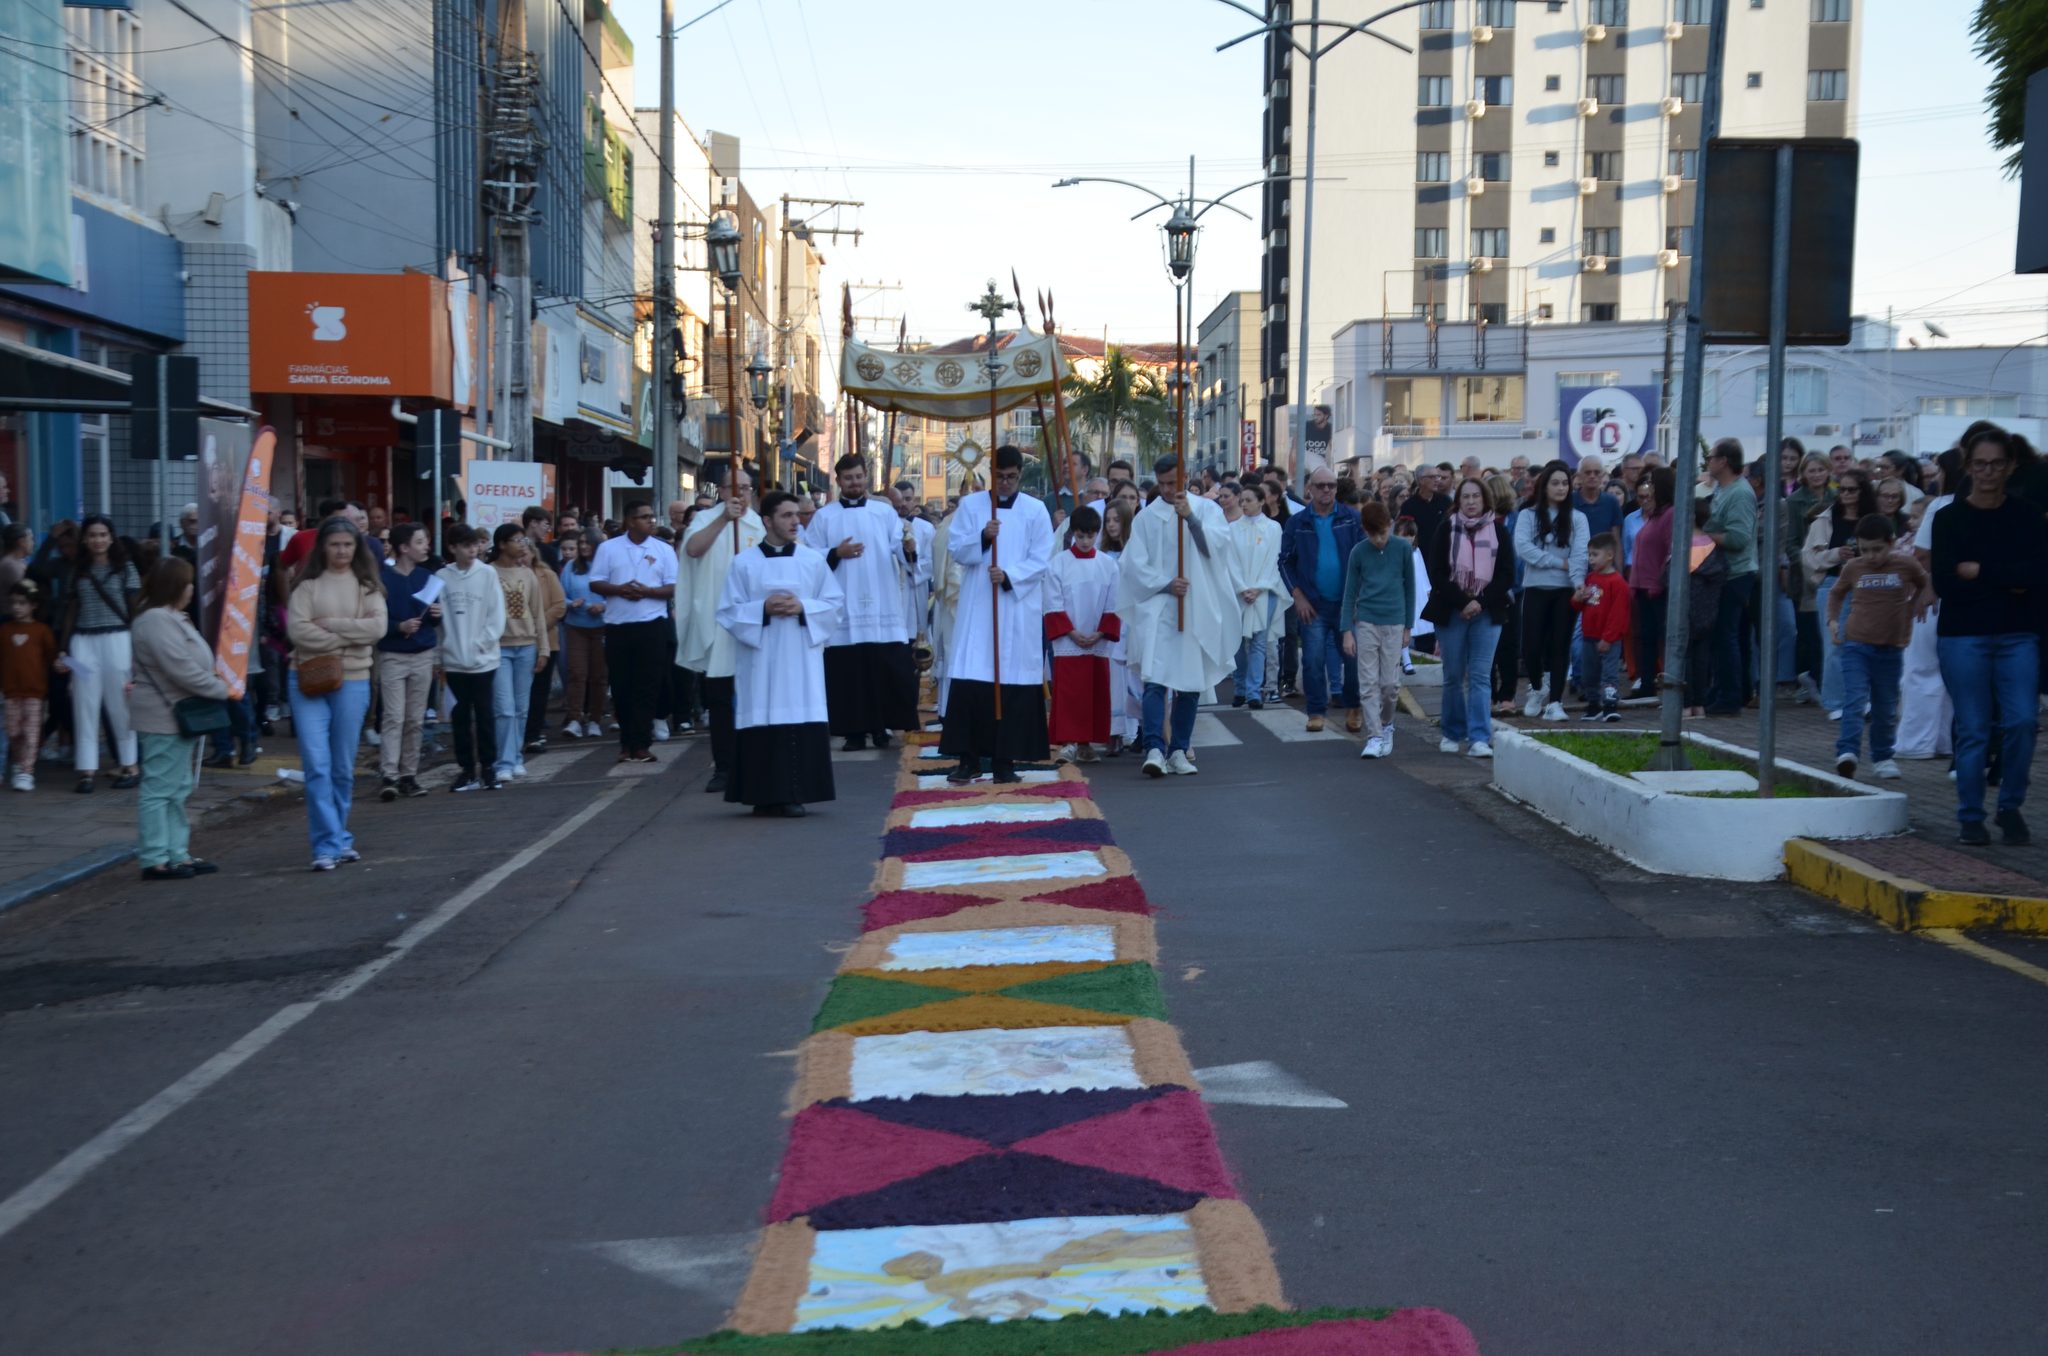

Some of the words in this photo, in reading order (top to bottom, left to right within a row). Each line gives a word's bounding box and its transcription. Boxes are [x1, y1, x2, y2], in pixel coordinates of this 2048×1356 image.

[288, 364, 349, 375] FARMÁCIAS
[288, 375, 327, 385] SANTA
[331, 376, 391, 386] ECONOMIA
[1304, 440, 1327, 448] rban
[474, 483, 535, 498] OFERTAS
